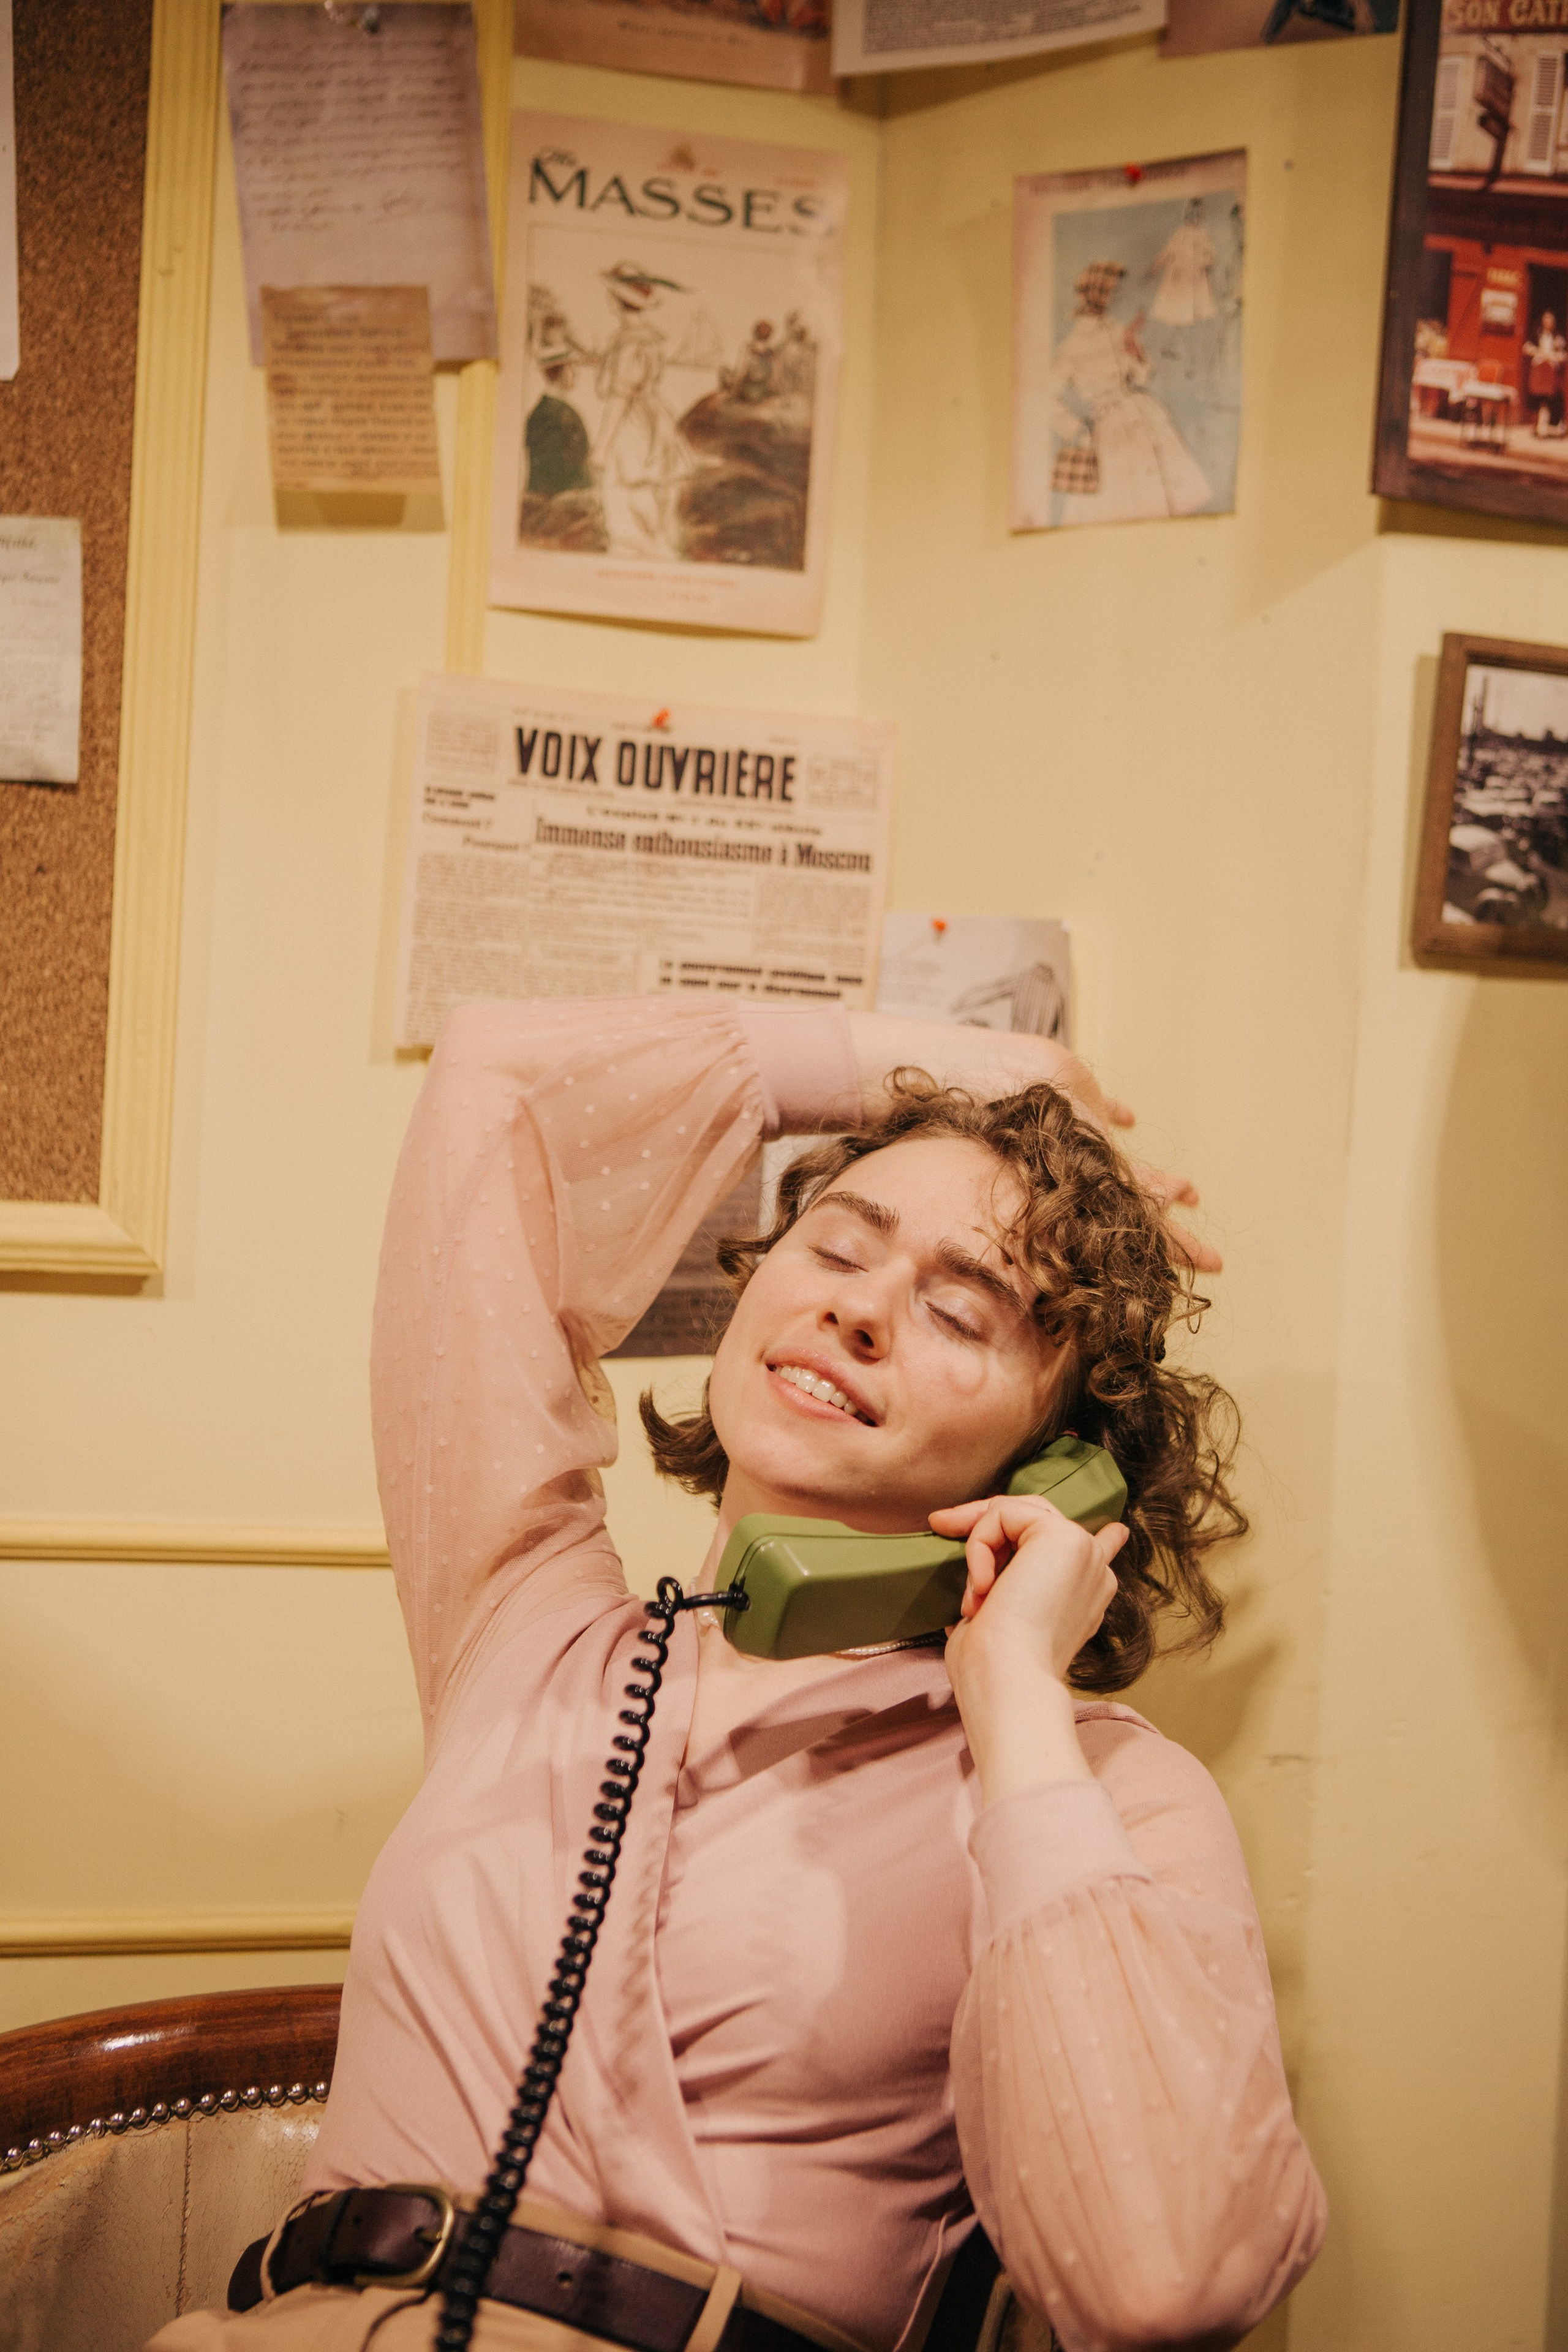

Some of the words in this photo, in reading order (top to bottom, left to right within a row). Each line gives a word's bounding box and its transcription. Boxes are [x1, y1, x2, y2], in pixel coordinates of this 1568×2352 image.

[528, 157, 835, 238] MASSES
[515, 725, 601, 783] VOIX
[617, 741, 797, 802] OUVRIÈRE
[535, 816, 626, 851] Immense
